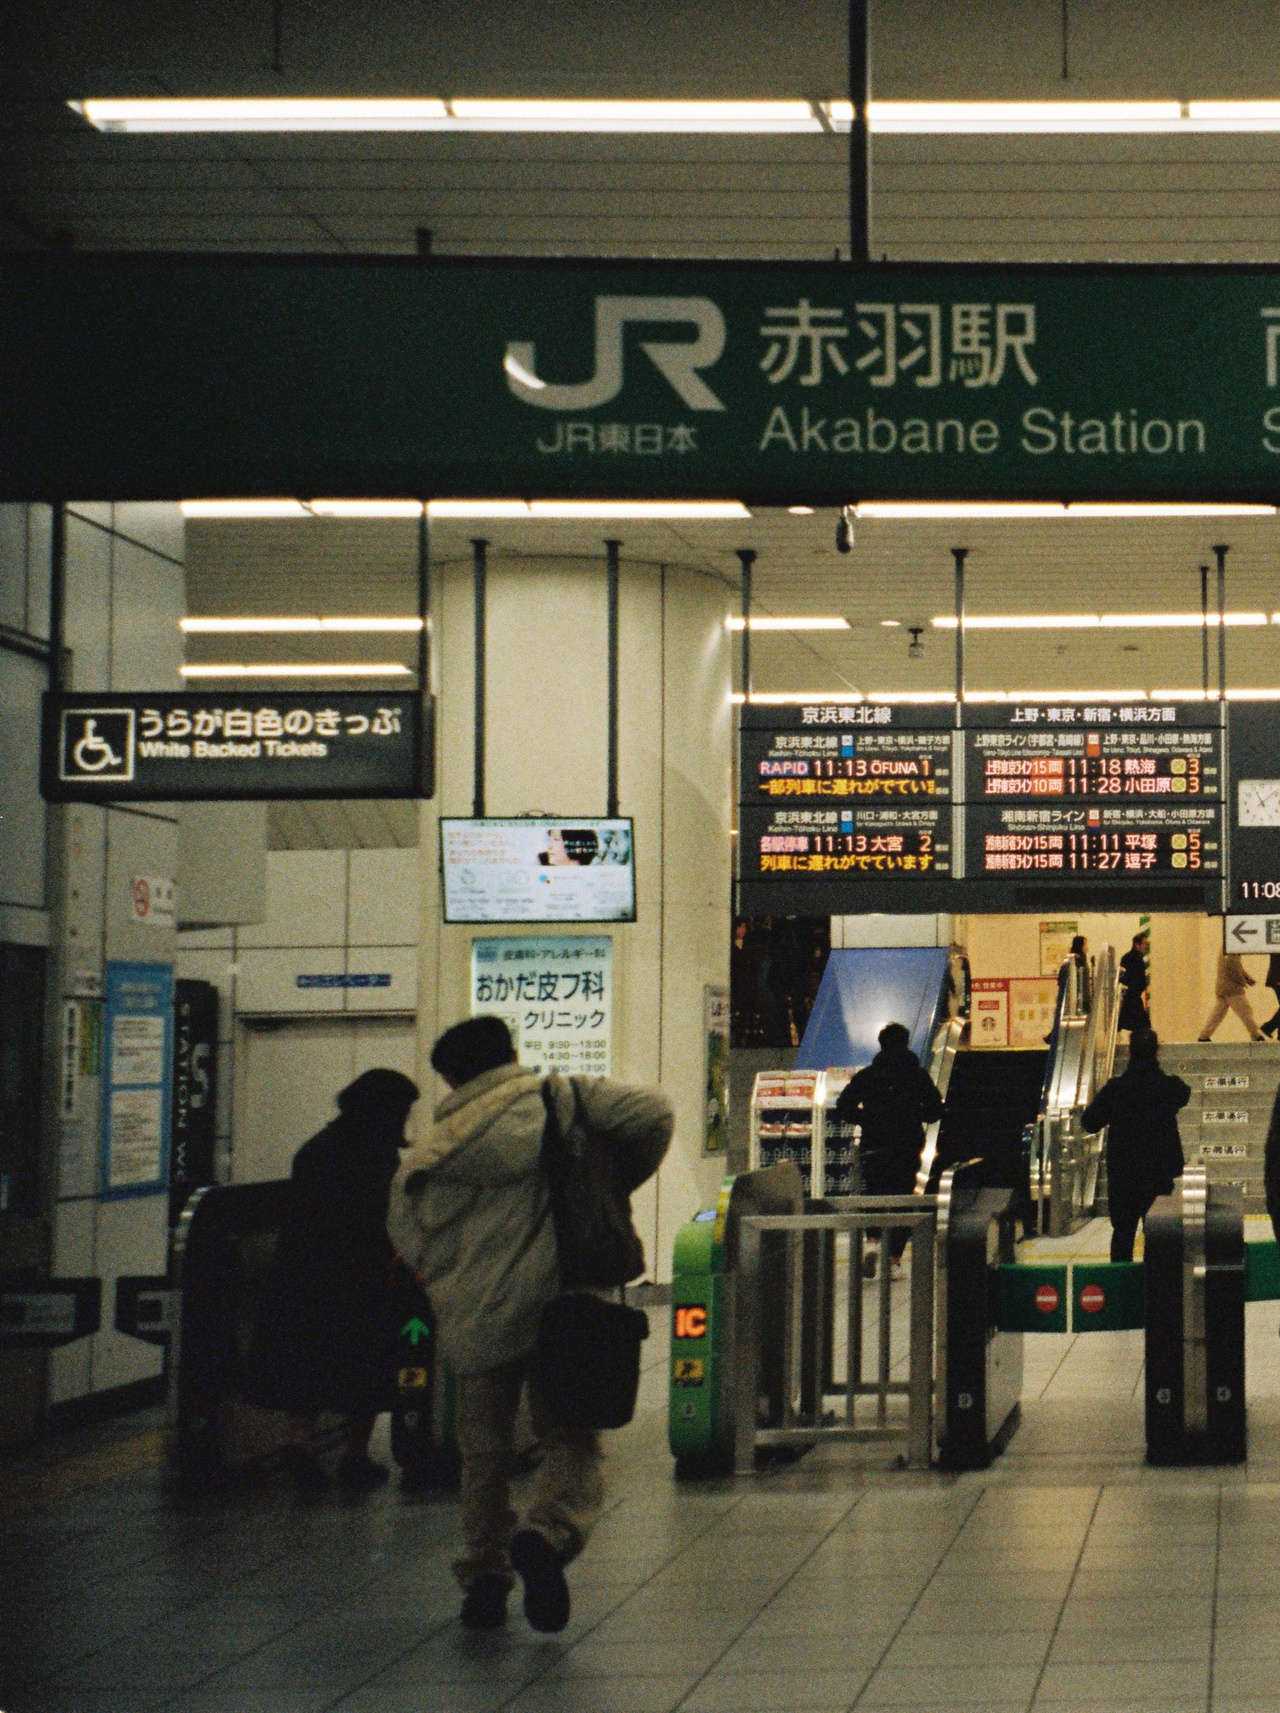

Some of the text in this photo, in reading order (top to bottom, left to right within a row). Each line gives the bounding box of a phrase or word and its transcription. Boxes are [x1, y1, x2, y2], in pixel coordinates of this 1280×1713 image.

[760, 300, 1038, 388] 赤羽駅
[506, 296, 726, 411] JR
[760, 406, 1206, 454] Akabane Station
[537, 424, 699, 455] JR東日本
[141, 708, 401, 737] うらが白色のきっぷ
[802, 707, 892, 724] 京浜東北線
[1011, 707, 1176, 723] 上野・東京・新宿・横浜方面
[140, 741, 327, 757] White Backed Tickets
[775, 736, 838, 749] 京浜東北線
[760, 761, 808, 775] RAPID
[815, 760, 867, 776] 11:13
[1069, 759, 1121, 775] 11:18
[1124, 759, 1156, 775] 熱海
[1188, 759, 1200, 775] 3
[1069, 777, 1121, 794] 11:28
[1124, 777, 1171, 793] 小田原
[1188, 777, 1200, 793] 3
[775, 811, 838, 824] 京浜東北線
[1001, 810, 1085, 823] 湘南新宿ライン
[815, 836, 867, 852] 11:13
[871, 836, 903, 852] 大宮
[920, 836, 931, 852] 2
[1069, 834, 1119, 850] 11:11
[1125, 834, 1157, 850] 平塚
[1189, 834, 1200, 849] 5
[1069, 853, 1120, 869] 11:27
[1124, 853, 1157, 868] 逗子
[1189, 853, 1200, 868] 5
[477, 970, 604, 1002] おかだ皮フ科
[525, 1009, 604, 1029] クリニック
[676, 1308, 707, 1337] IC
